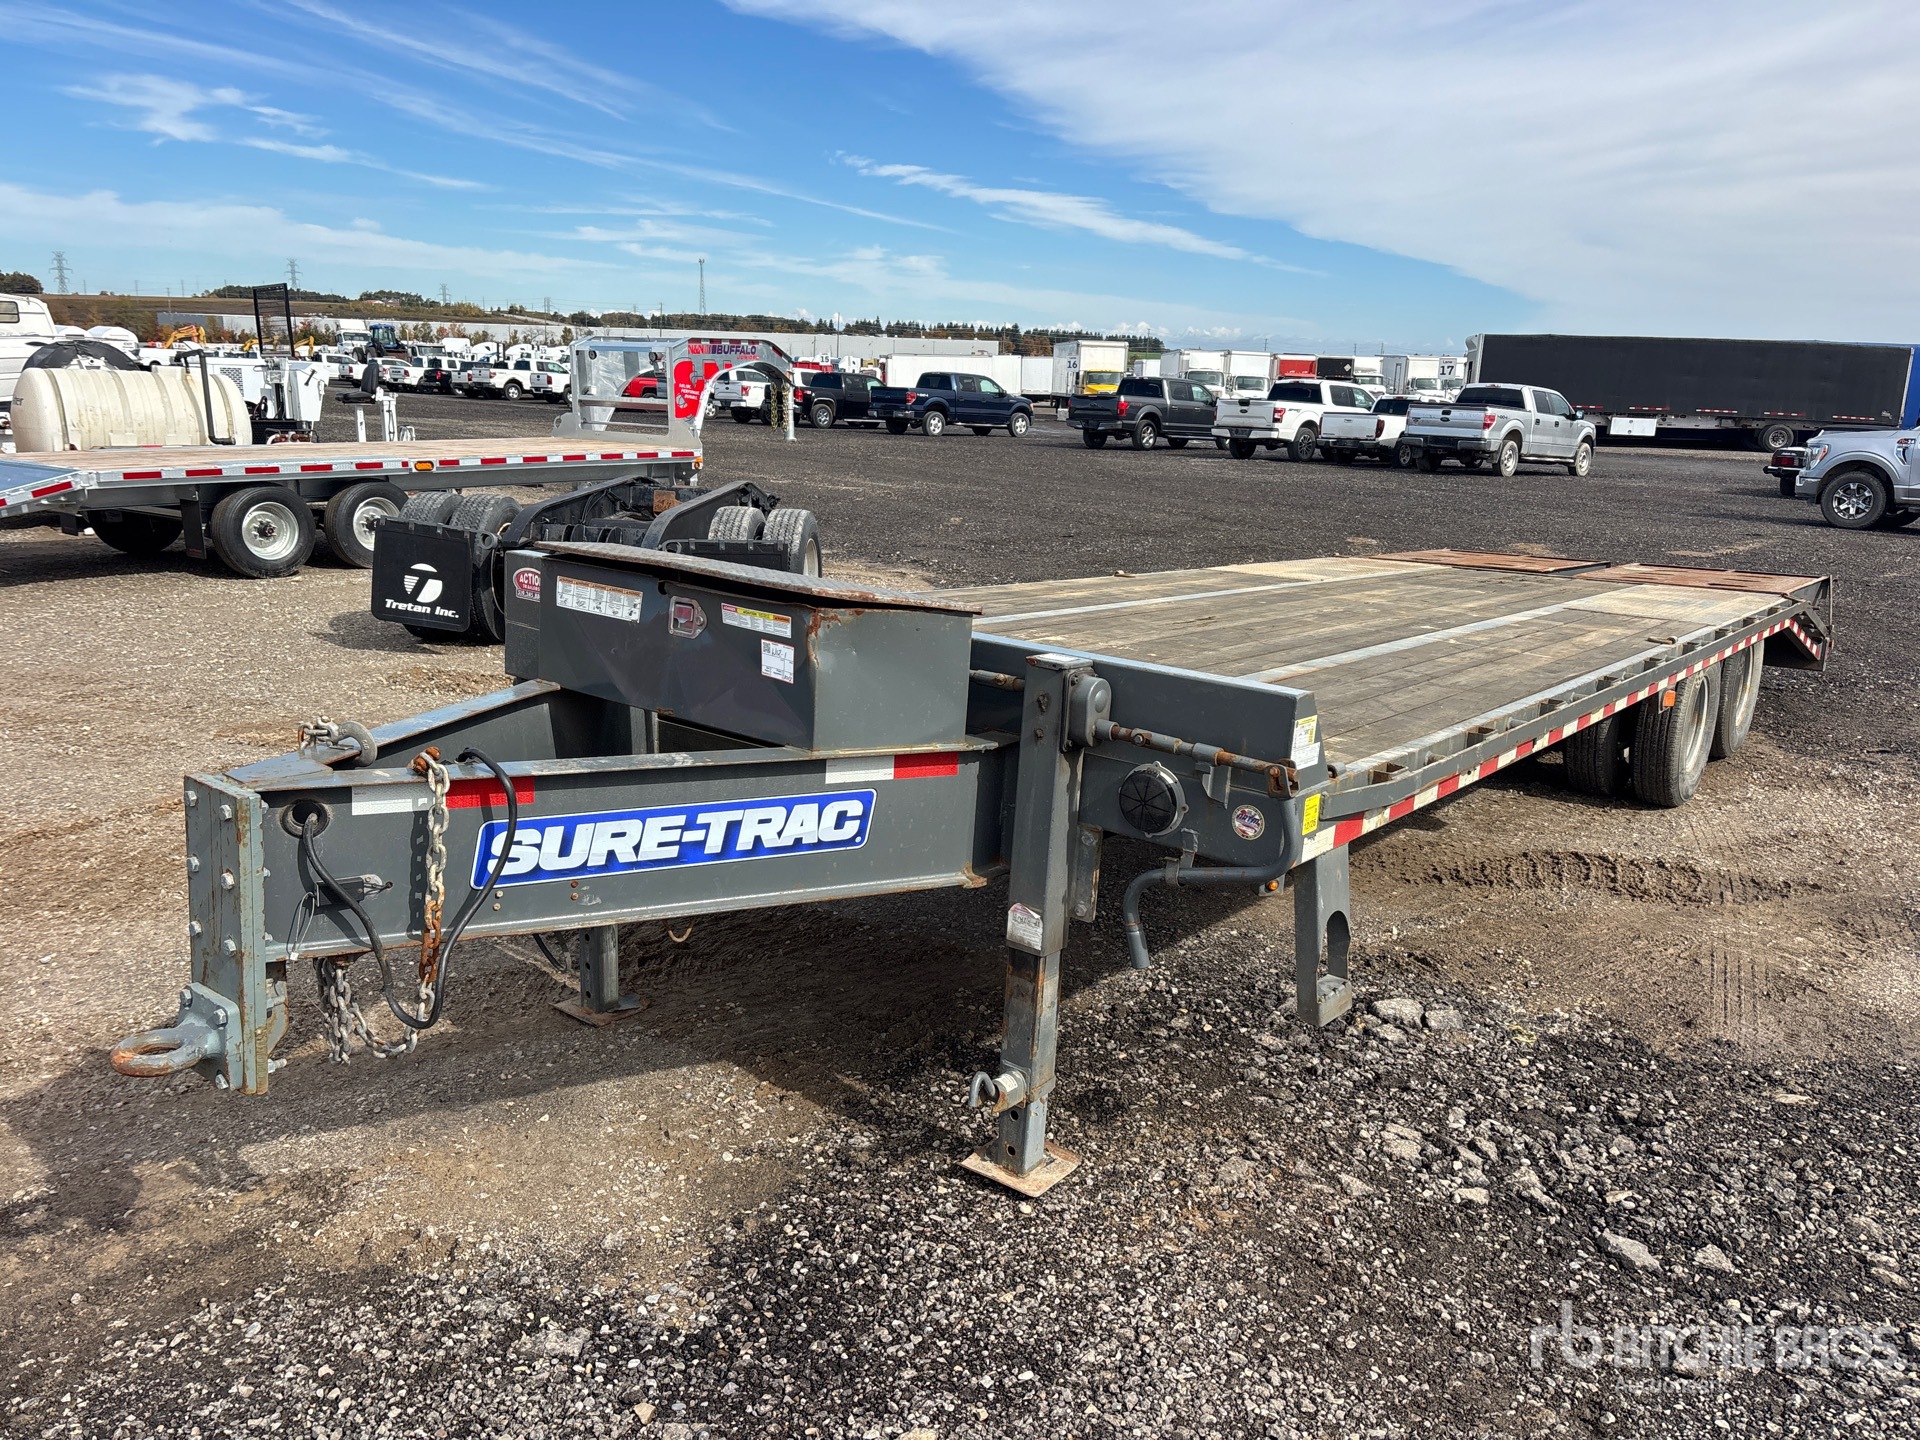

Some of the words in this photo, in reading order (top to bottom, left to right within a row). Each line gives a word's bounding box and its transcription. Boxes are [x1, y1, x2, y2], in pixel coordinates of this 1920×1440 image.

[717, 345, 757, 355] BUFFALO
[820, 355, 830, 363] 15
[1066, 360, 1078, 369] 16
[1439, 365, 1455, 376] 17
[385, 598, 432, 614] Tretan
[434, 606, 460, 619] Inc.
[487, 799, 865, 876] SURE-TRAC
